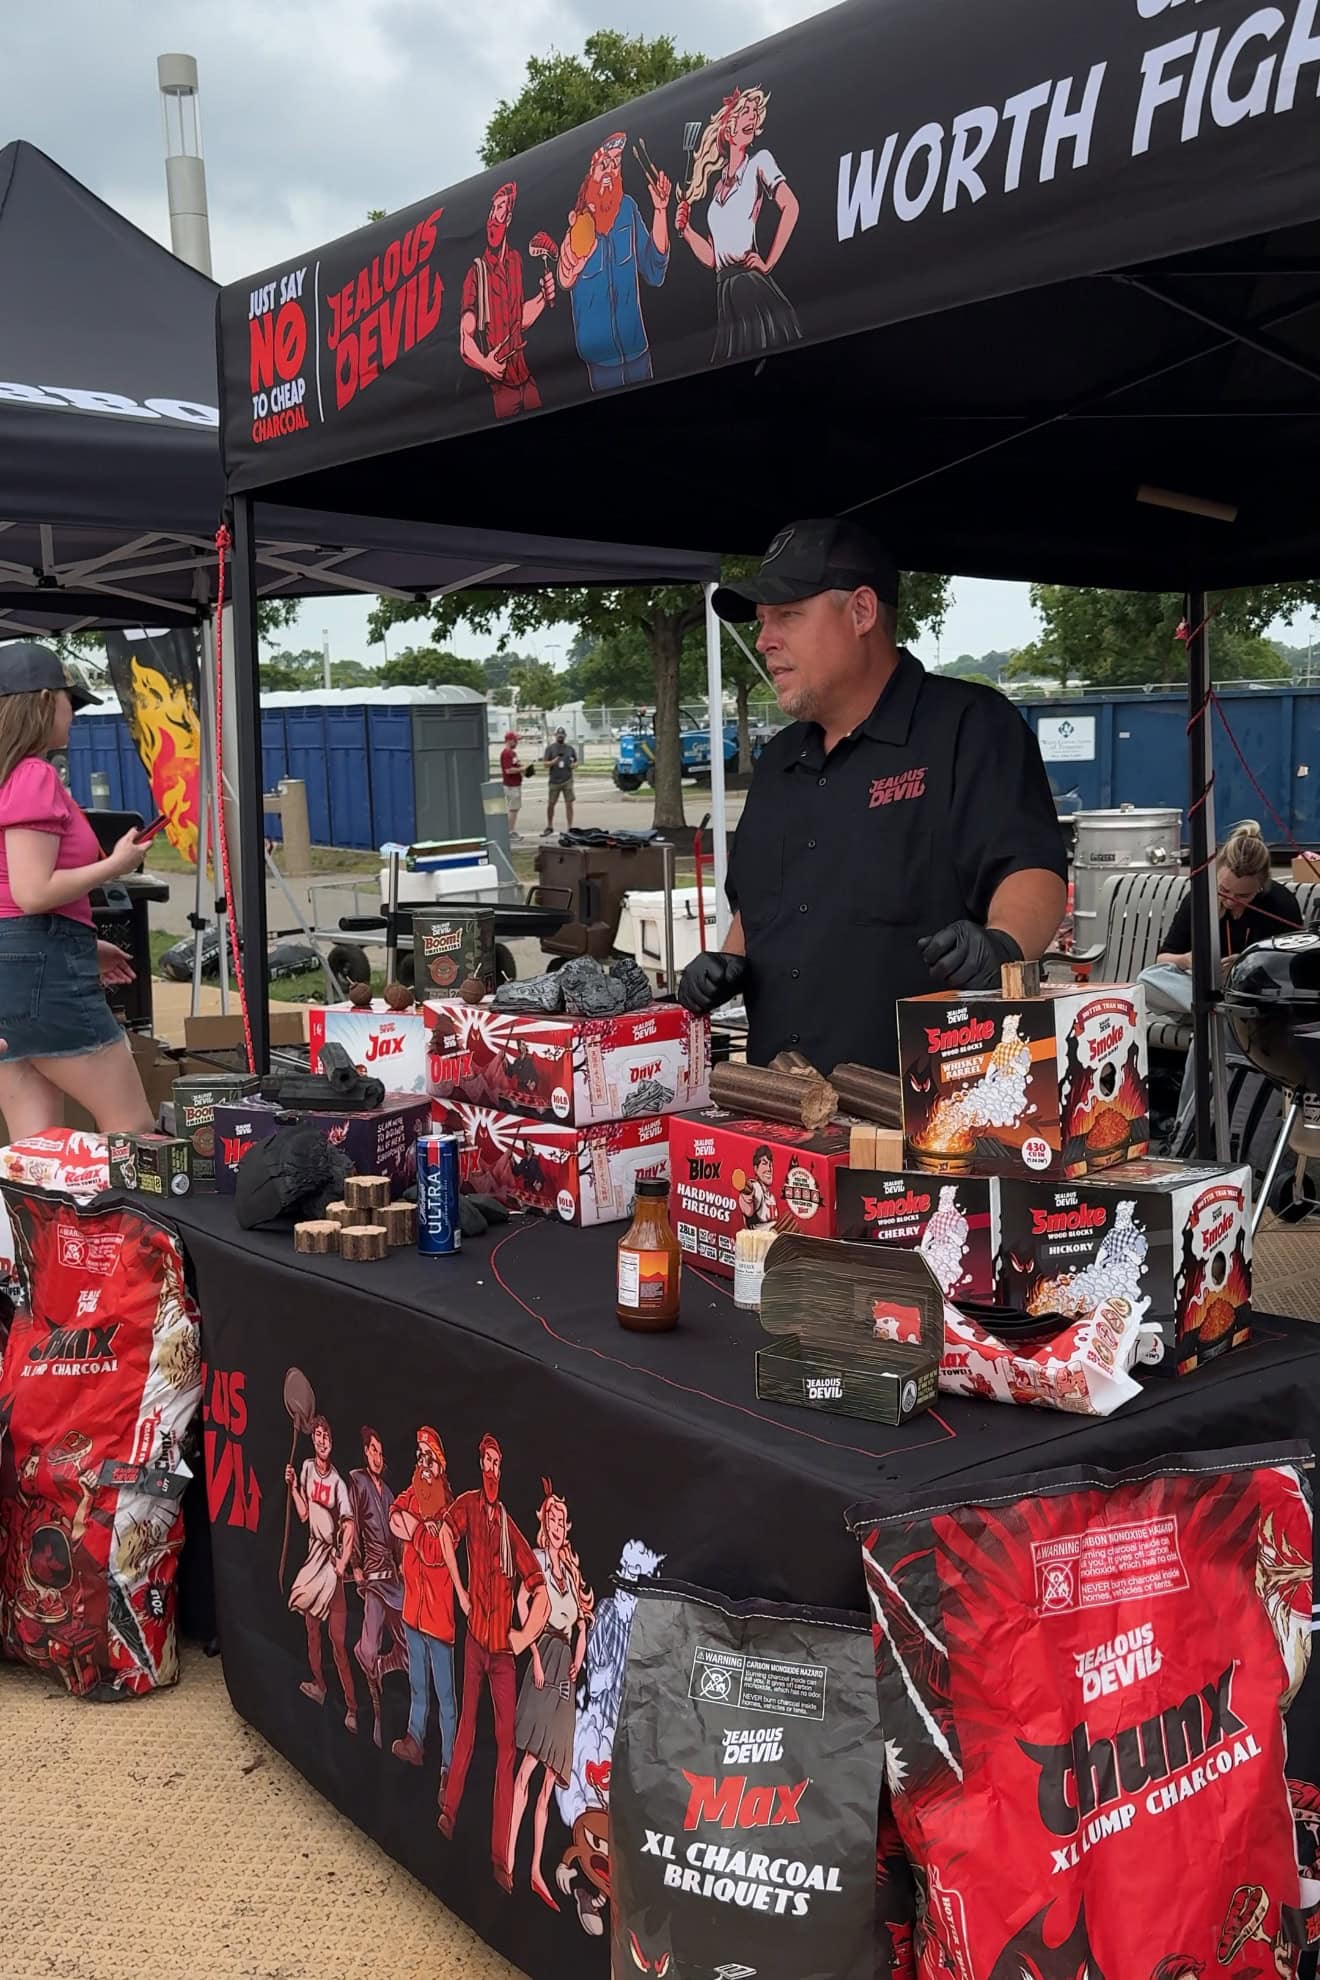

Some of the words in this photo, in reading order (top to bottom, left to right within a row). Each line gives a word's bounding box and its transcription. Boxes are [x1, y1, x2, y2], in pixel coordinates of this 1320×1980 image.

[836, 61, 1107, 242] WORTH
[327, 208, 444, 350] JEALOUS
[249, 281, 276, 320] JUST
[280, 266, 307, 304] SAY
[335, 264, 445, 411] DEVIL
[252, 395, 268, 420] TO
[270, 378, 306, 413] CHEAP
[252, 404, 309, 443] CHARCOAL
[868, 767, 929, 794] JEALOUS
[868, 780, 926, 809] DEVIL
[422, 927, 463, 950] Boom!
[948, 1014, 969, 1024] DEVIL
[634, 1024, 657, 1041] DEVIL
[924, 1017, 995, 1053] Smoke
[1087, 1025, 1123, 1061] Smoke
[366, 1033, 406, 1062] Jax
[960, 1042, 983, 1054] BLOCKS
[427, 1050, 474, 1087] Onyx
[629, 1060, 662, 1084] Onyx
[942, 1056, 985, 1073] WHISKEY
[945, 1065, 982, 1079] BARREL
[639, 1126, 663, 1143] DEVIL
[1026, 1142, 1046, 1151] 430
[695, 1145, 716, 1157] DEVIL
[687, 1156, 722, 1181] Blox
[677, 1182, 737, 1211] HARDWOOD
[884, 1184, 905, 1195] DEVIL
[427, 1171, 442, 1235] ULTRA
[682, 1197, 730, 1222] FIRELOGS
[860, 1189, 931, 1221] Smoke
[1055, 1198, 1078, 1207] DEVIL
[679, 1223, 696, 1237] 28LB
[1028, 1203, 1107, 1235] Smoke
[878, 1225, 920, 1239] CHERRY
[1048, 1231, 1068, 1240] WOOD
[1068, 1228, 1094, 1237] BLOCKS
[1201, 1212, 1234, 1253] Smoke
[1049, 1242, 1094, 1255] HICKORY
[52, 1359, 118, 1377] CHARCOAL
[942, 1368, 973, 1376] TOWELS
[806, 1377, 841, 1389] JEALOUS
[808, 1386, 843, 1399] DEVIL
[1041, 1541, 1080, 1558] WARNING
[1082, 1581, 1110, 1594] NEVER
[1128, 1573, 1161, 1586] charcoal
[1072, 1621, 1154, 1677] JEALOUS
[705, 1650, 743, 1668] WARNING
[746, 1660, 770, 1671] CARBON
[770, 1663, 800, 1676] MONOXIDE
[800, 1667, 824, 1679] HAZARD
[1081, 1646, 1165, 1704] DEVIL
[742, 1692, 763, 1702] NEVER
[721, 1727, 784, 1746] JEALOUS
[722, 1743, 784, 1765] DEVIL
[681, 1766, 811, 1832] Max
[1050, 1842, 1080, 1874] XL
[1081, 1803, 1136, 1854] LUMP
[1146, 1740, 1262, 1815] CHARCOAL
[639, 1829, 677, 1860] XL
[685, 1841, 844, 1893] CHARCOAL
[662, 1862, 812, 1917] BRIQUETS
